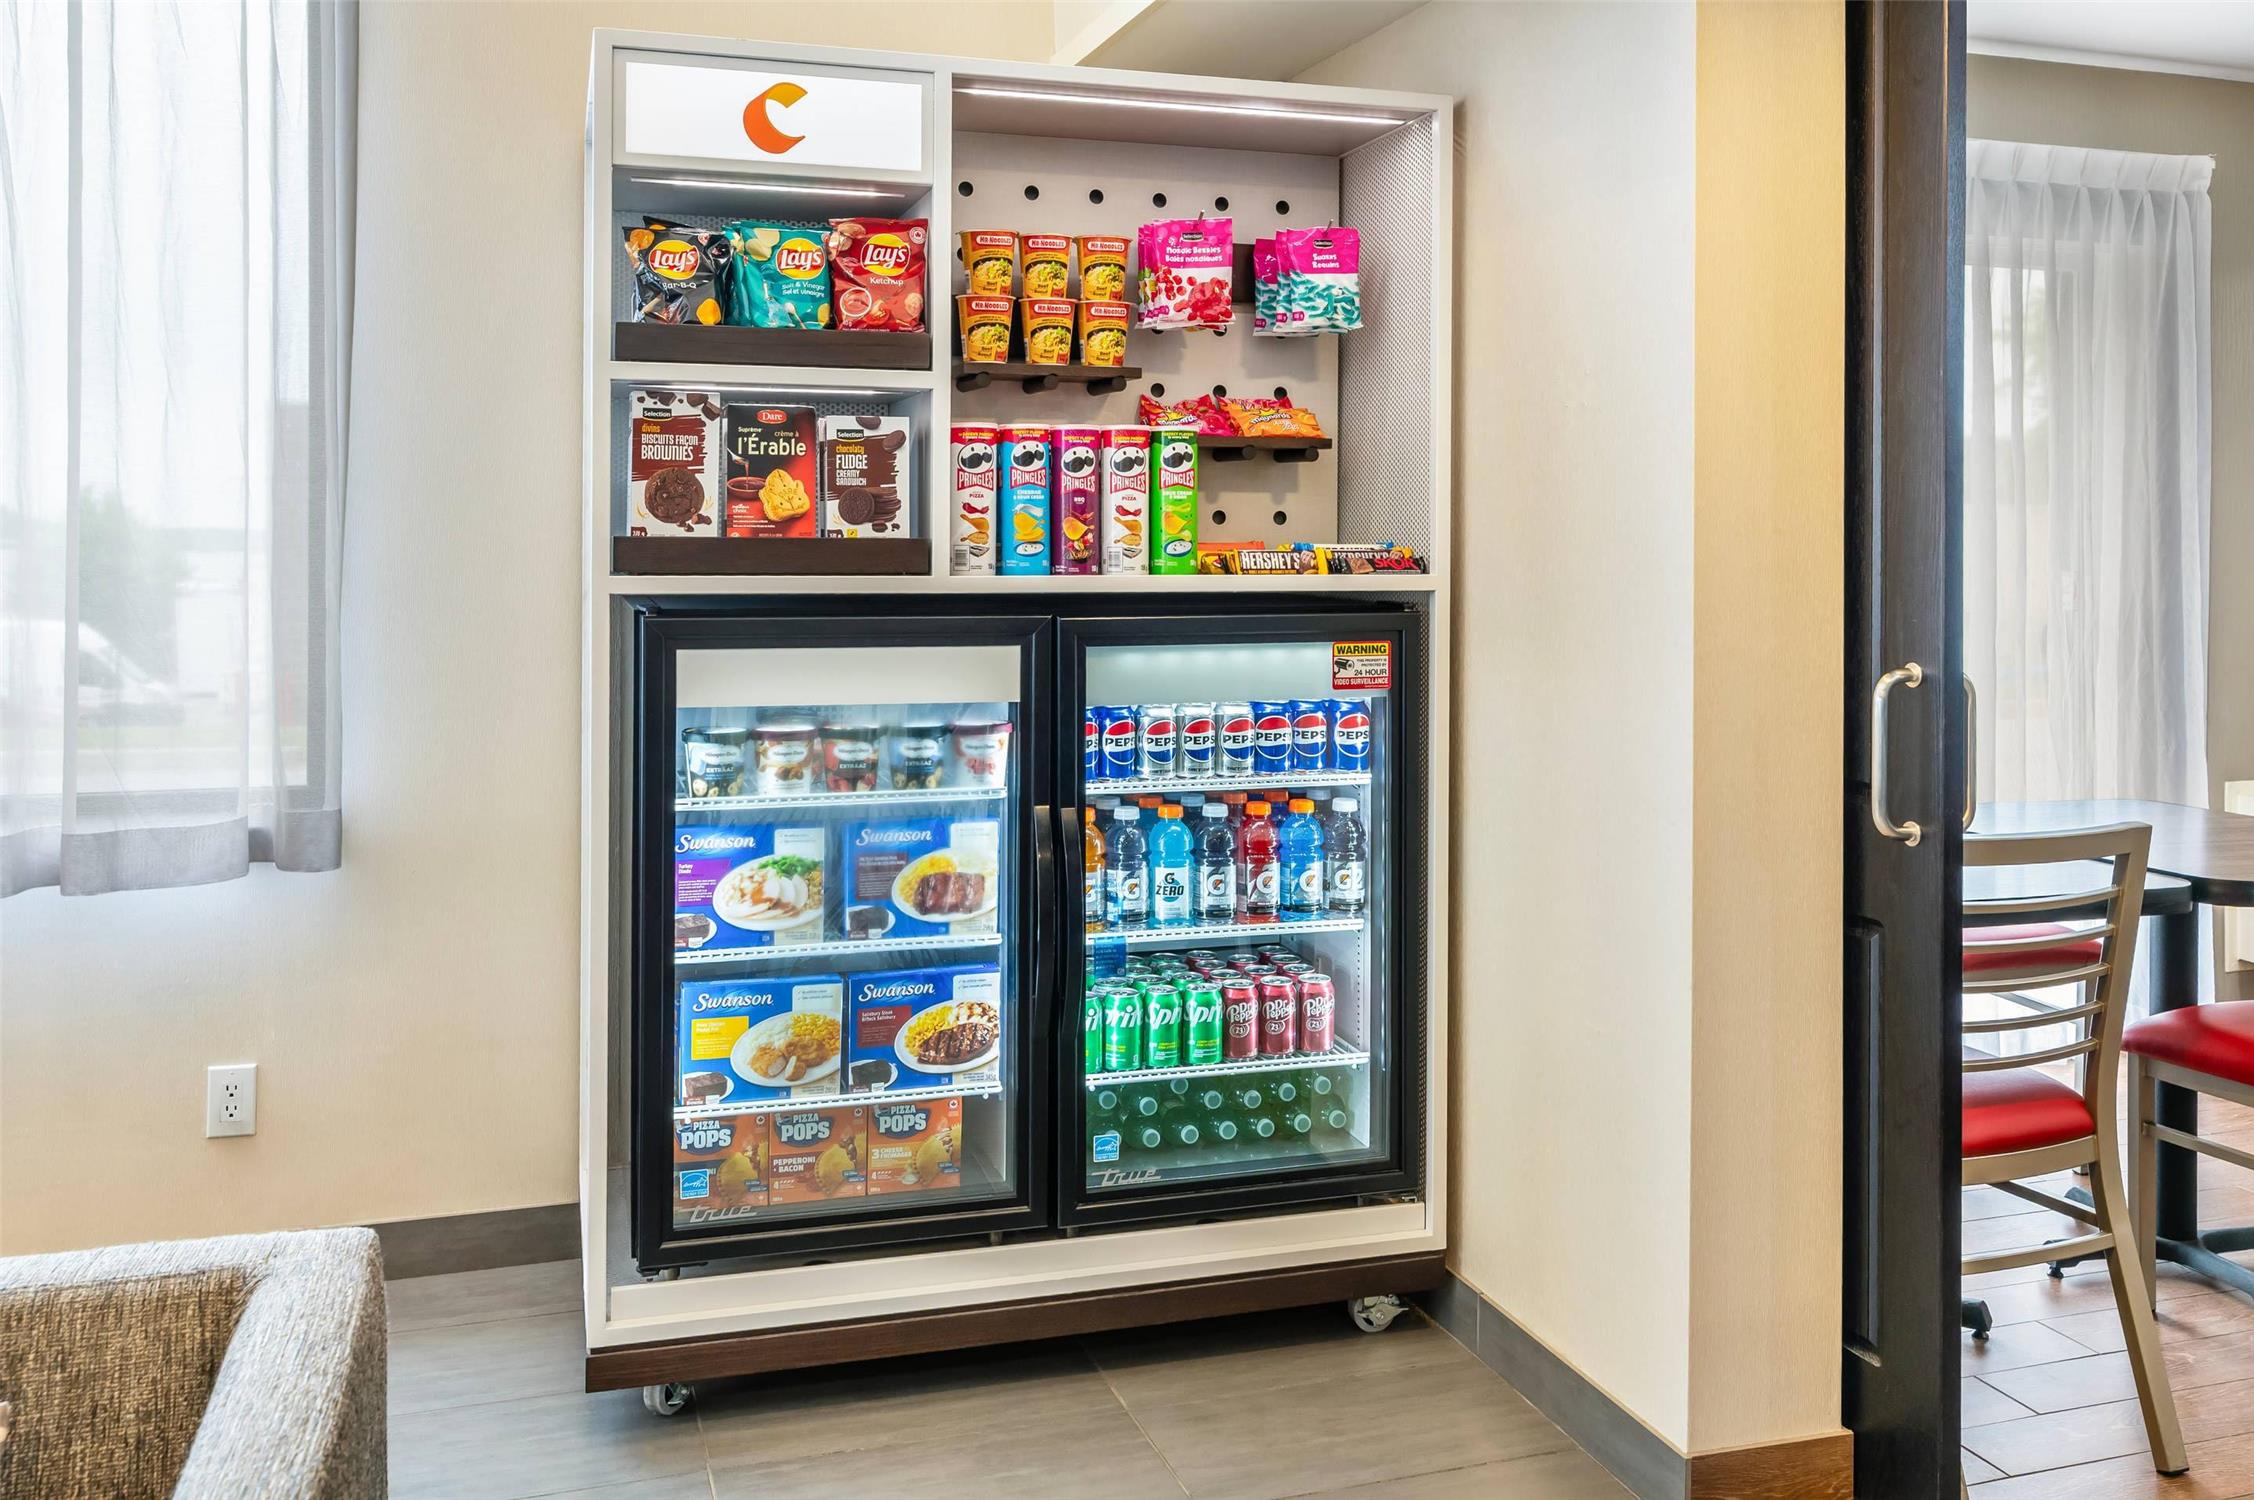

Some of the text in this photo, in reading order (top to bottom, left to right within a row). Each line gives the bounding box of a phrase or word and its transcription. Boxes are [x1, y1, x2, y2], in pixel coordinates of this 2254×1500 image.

[743, 82, 808, 154] C
[651, 249, 696, 272] Lay's
[780, 249, 822, 271] Lay's
[865, 243, 907, 268] Lay's
[870, 277, 904, 287] Ketchup
[985, 302, 1008, 310] NOODLES
[643, 410, 671, 418] Selection
[761, 412, 783, 421] Dare
[641, 433, 674, 444] BISCUITS
[641, 445, 693, 461] BROWNIES
[836, 444, 865, 454] chocolaty
[836, 454, 868, 469] FUDGE
[836, 470, 860, 478] CREAMY
[959, 470, 993, 489] PRINGLES
[1012, 468, 1046, 489] PRINGLES
[1160, 469, 1195, 487] PRINGLES
[836, 478, 867, 486] SANDWICH
[1062, 475, 1096, 492] PRINGLES
[1111, 474, 1146, 492] PRINGLES
[1240, 552, 1300, 569] HERSHEY'S
[1375, 558, 1419, 570] SKOR
[1336, 645, 1387, 655] WARNING
[1334, 677, 1388, 686] VIDEO SURVEILLANCE
[1184, 735, 1215, 745] PEPS
[1223, 734, 1254, 744] PEPS
[1256, 732, 1288, 742] PEPS
[1294, 730, 1326, 740] PEPS
[1338, 730, 1369, 740] PEPS
[1105, 737, 1135, 747] PEPS
[1147, 737, 1176, 747] PEPS
[856, 828, 932, 846] Swanson
[675, 834, 756, 853] Swanson
[1165, 872, 1175, 884] G
[1156, 885, 1184, 896] ZERO
[858, 983, 935, 1002] Swanson
[693, 993, 774, 1012] Swanson
[1270, 1023, 1278, 1031] 23
[891, 1105, 916, 1114] PIZZA
[793, 1113, 819, 1122] PIZZA
[879, 1113, 927, 1133] POPS
[693, 1120, 720, 1131] PIZZA
[781, 1121, 831, 1142] POPS
[680, 1129, 731, 1149] POPS
[872, 1149, 879, 1159] 3
[773, 1156, 816, 1165] PEPPERONI
[779, 1164, 804, 1172] BACON
[1092, 1168, 1161, 1186] true
